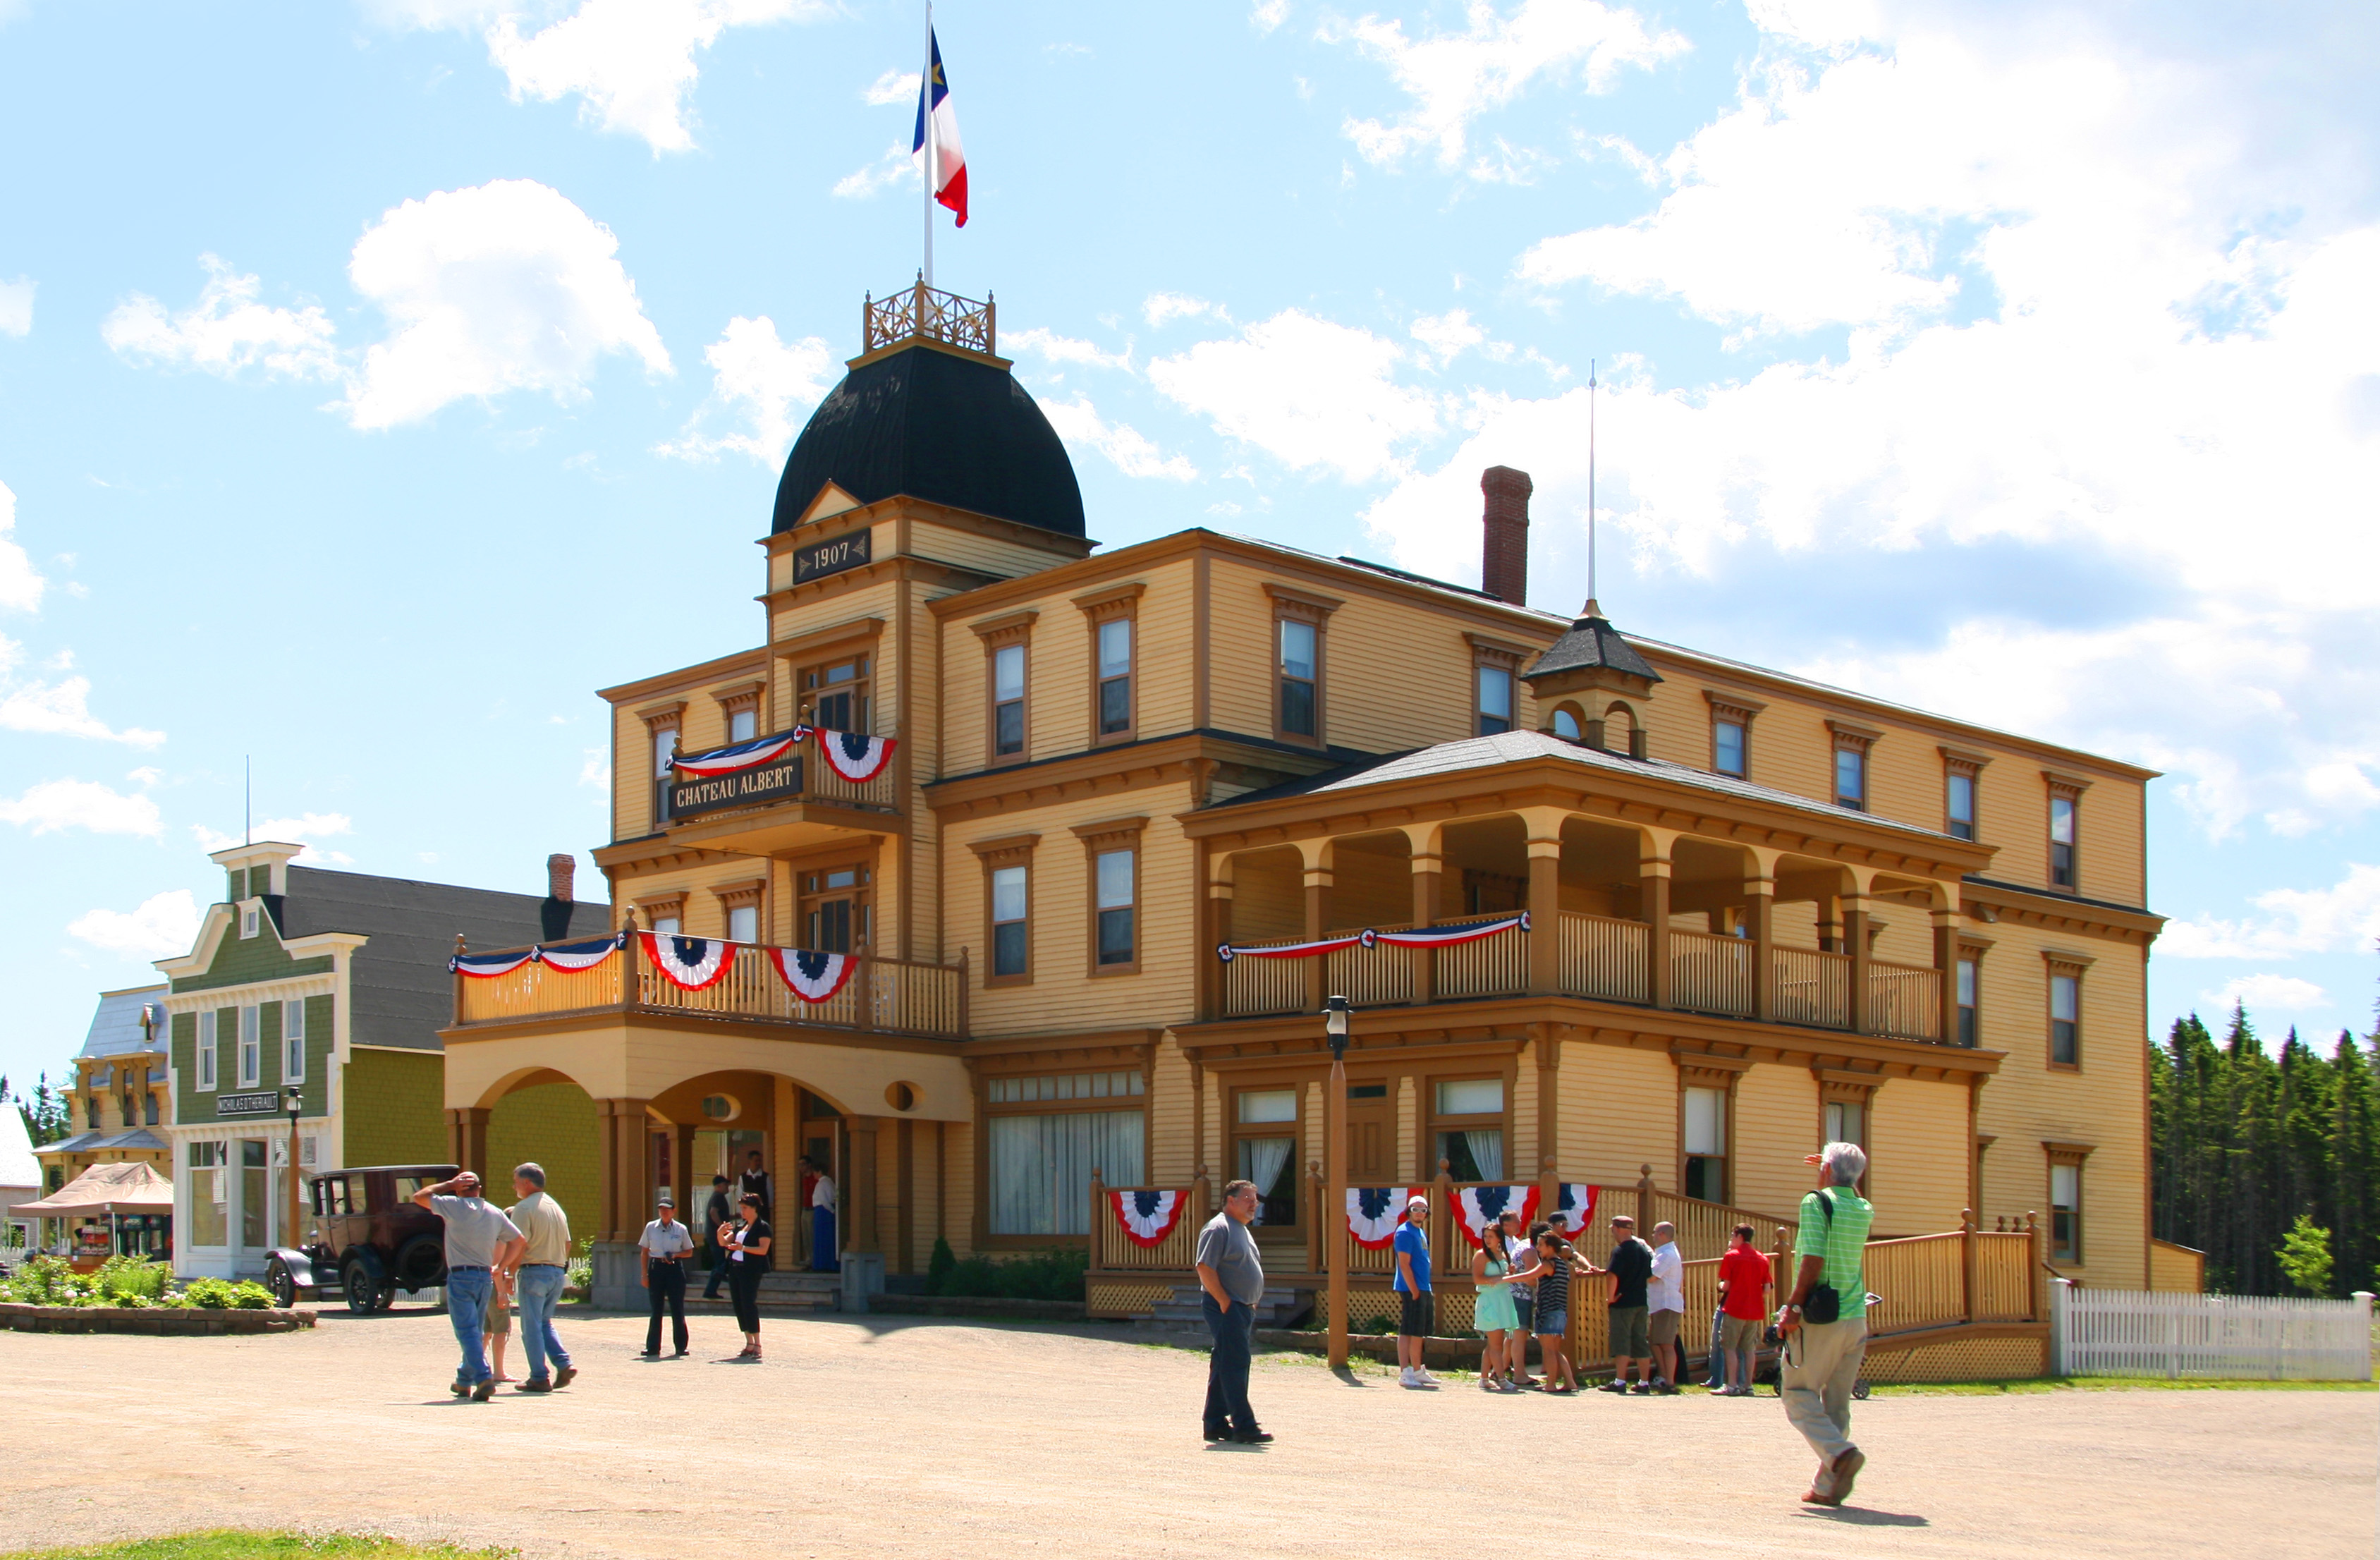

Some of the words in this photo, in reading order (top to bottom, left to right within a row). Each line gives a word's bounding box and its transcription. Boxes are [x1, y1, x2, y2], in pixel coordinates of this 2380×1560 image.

[814, 542, 848, 569] 1907
[677, 779, 736, 807] CHATEAU
[740, 766, 793, 794] ALBERT
